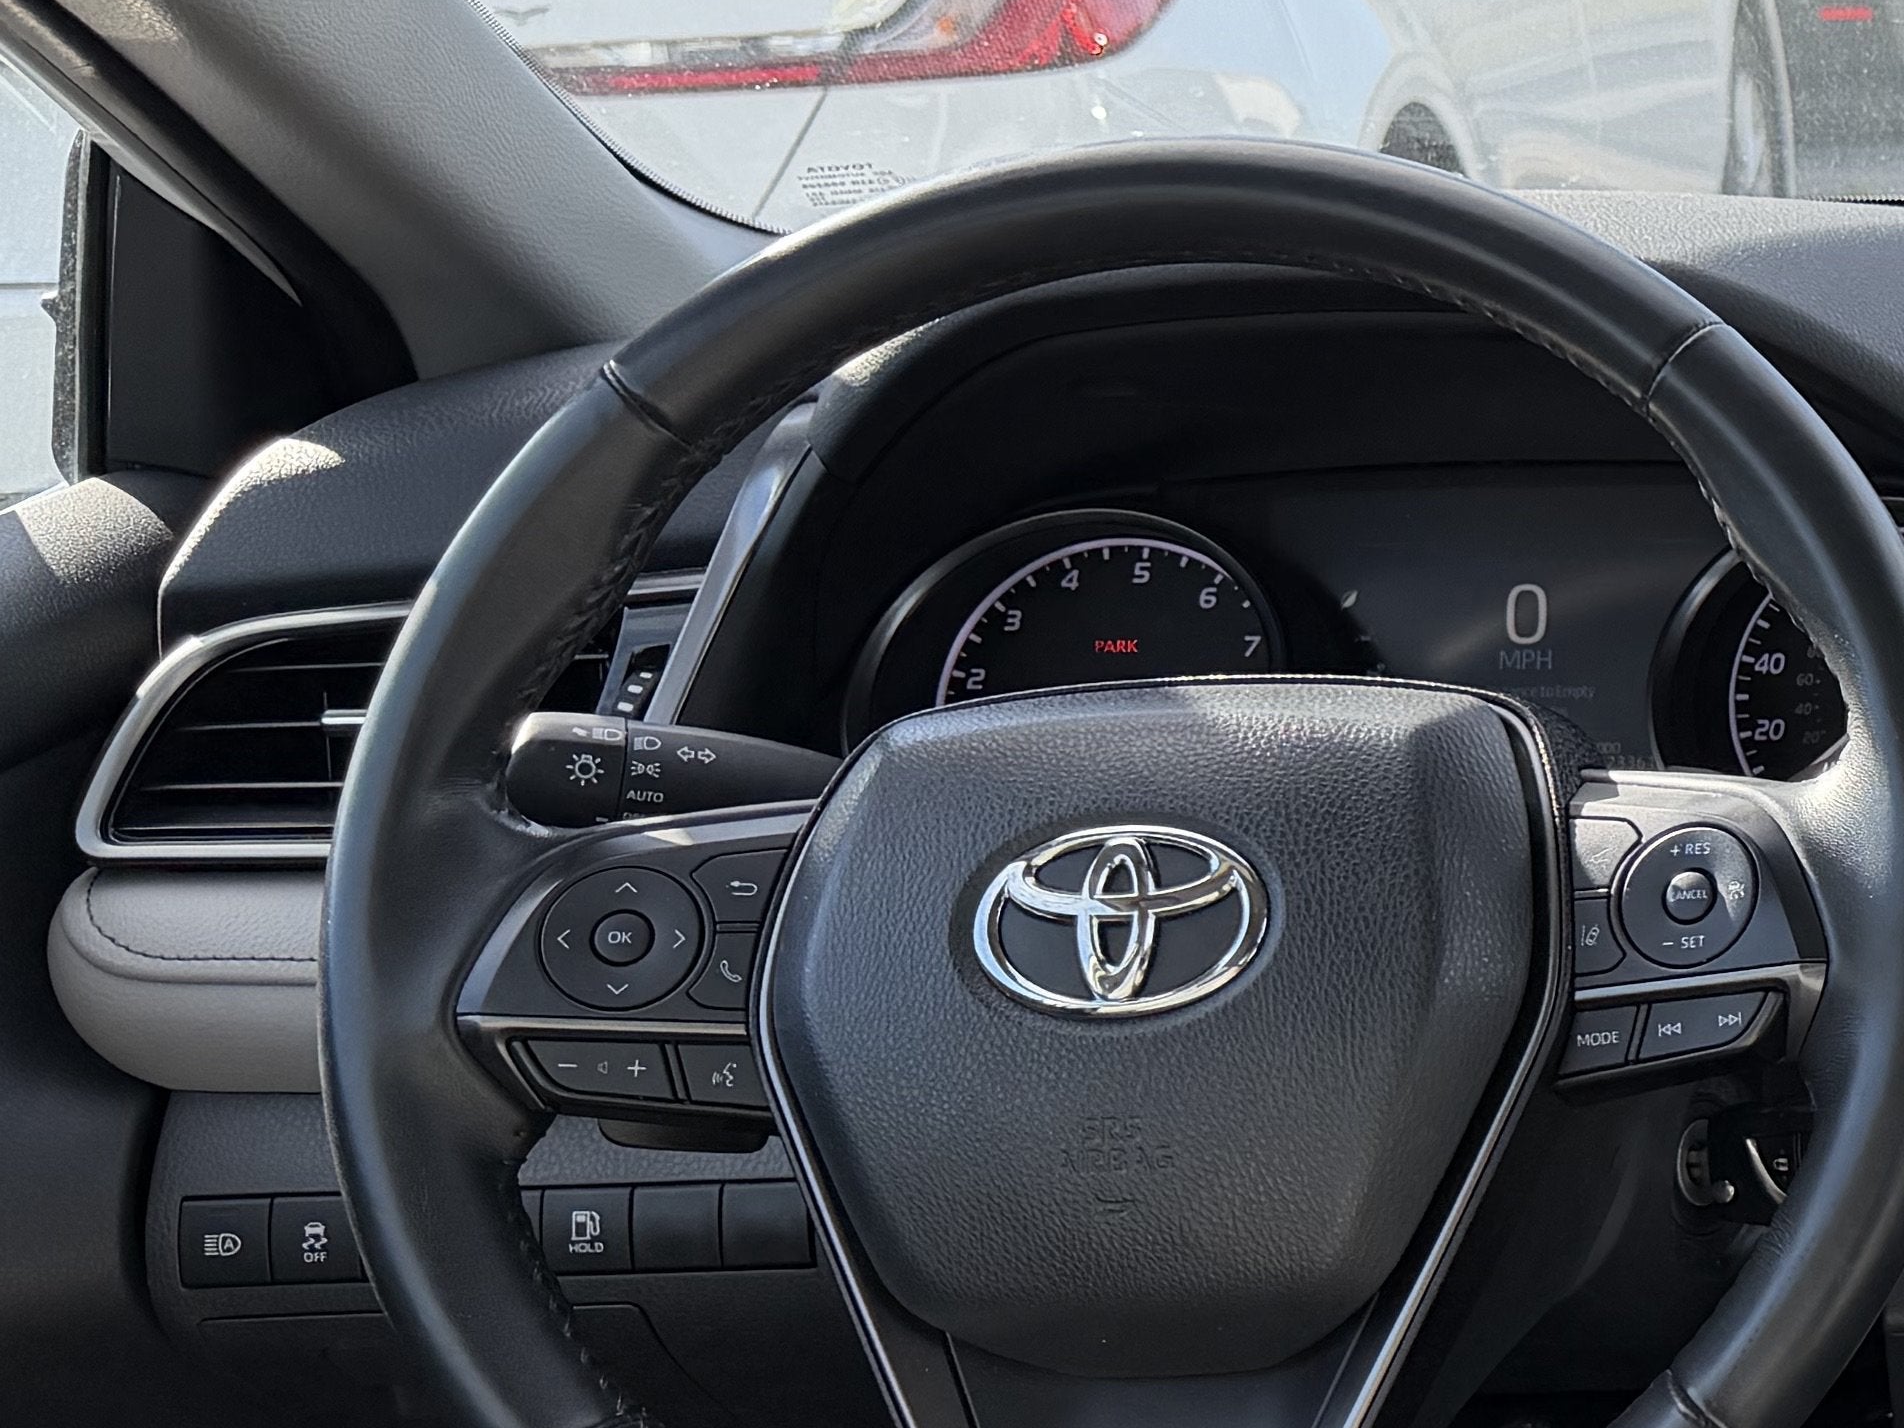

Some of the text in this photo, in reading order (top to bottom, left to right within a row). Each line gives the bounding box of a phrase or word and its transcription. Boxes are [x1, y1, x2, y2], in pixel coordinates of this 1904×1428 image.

[1060, 568, 1080, 591] 4
[1131, 562, 1151, 584] 5
[1199, 587, 1218, 610] 6
[1003, 610, 1022, 632] 3
[1505, 582, 1548, 645] 0
[1094, 638, 1139, 653] PARK
[1244, 635, 1262, 658] 7
[1498, 648, 1553, 671] MPH
[1754, 651, 1786, 675] 40
[966, 668, 986, 691] 2
[1796, 672, 1814, 687] 60
[1753, 718, 1786, 741] 20
[625, 789, 665, 804] AUTO
[1684, 842, 1711, 856] RES
[1670, 888, 1709, 902] CANCEL
[607, 930, 633, 945] OK
[1680, 936, 1706, 950] SET
[1576, 1031, 1621, 1047] MODE
[302, 1251, 328, 1264] OFF
[568, 1241, 605, 1255] HOLD
